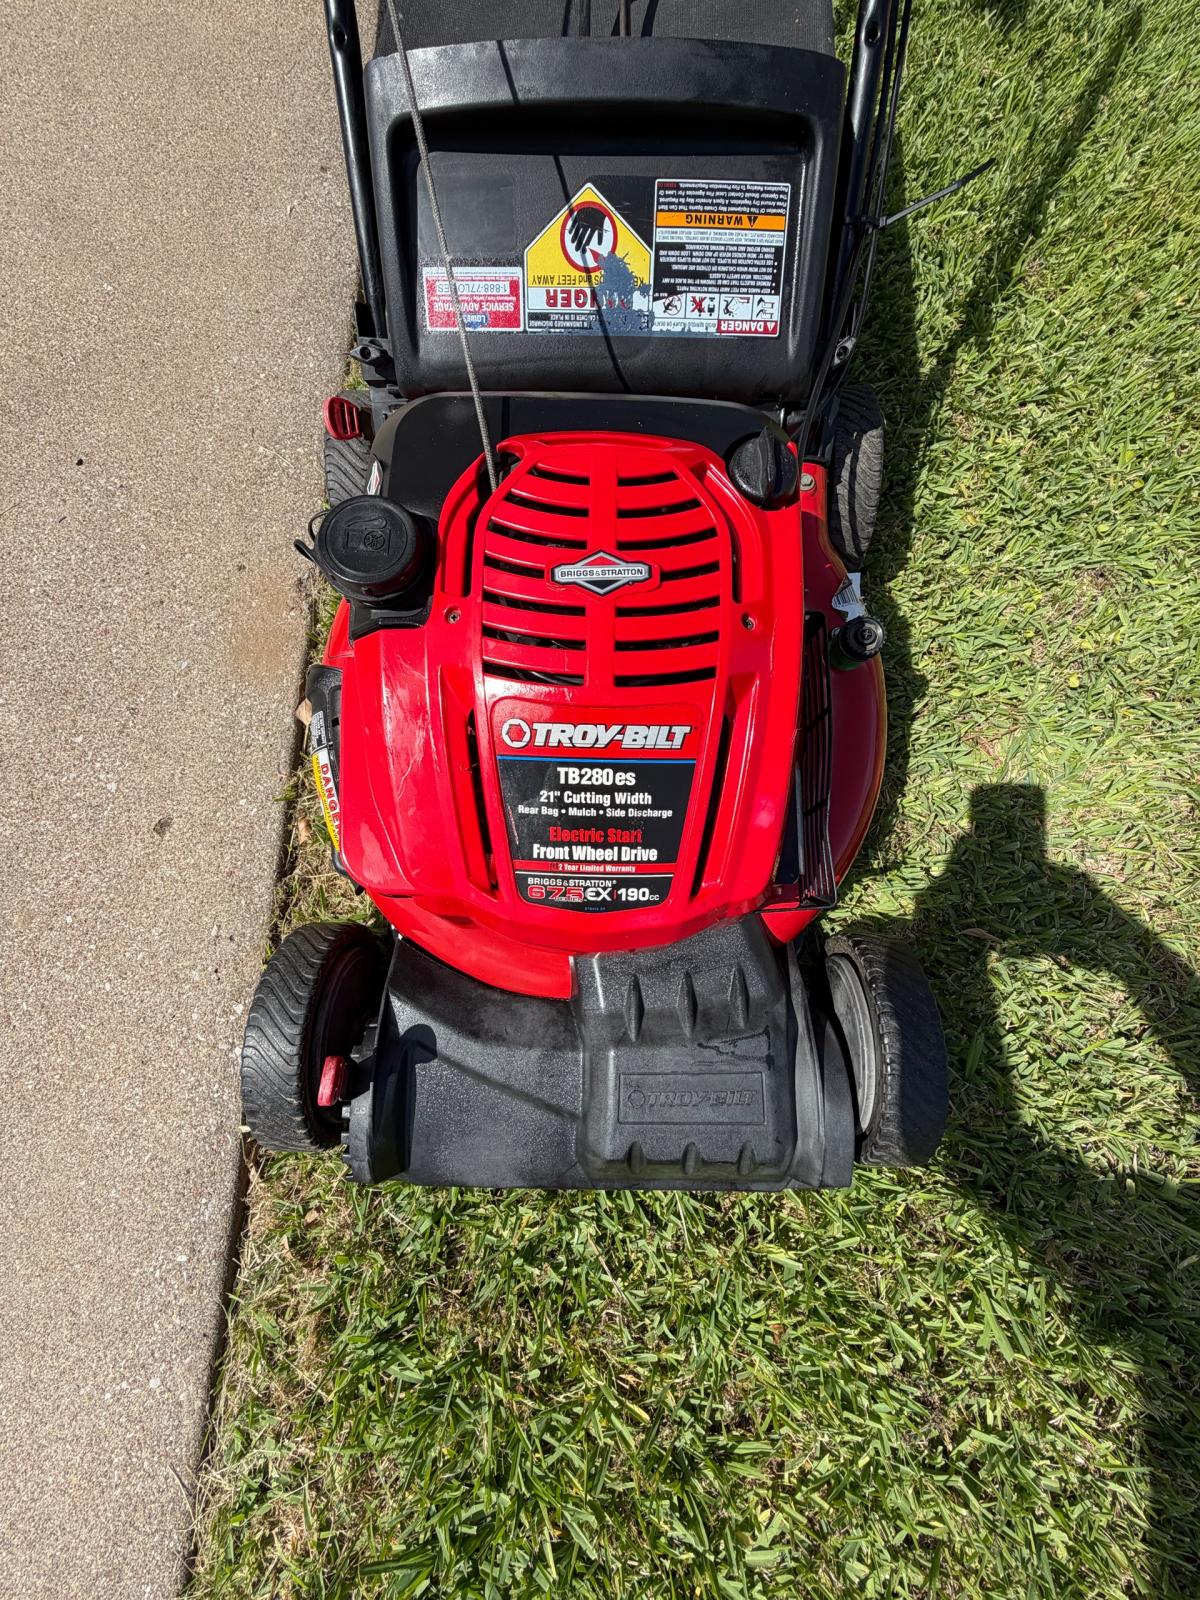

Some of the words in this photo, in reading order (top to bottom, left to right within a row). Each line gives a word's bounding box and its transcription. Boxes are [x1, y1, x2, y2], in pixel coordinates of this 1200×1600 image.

[685, 214, 743, 226] WARNING
[531, 274, 555, 285] AWAY
[557, 274, 577, 285] FEET
[578, 274, 592, 285] and
[437, 283, 507, 293] 1-888-77LOES
[481, 302, 514, 311] SERVICE
[720, 321, 765, 332] DANGER
[560, 569, 643, 577] BRIGGS&STRATTON
[531, 722, 692, 749] TROY-BILT
[539, 790, 561, 803] 21"
[563, 791, 611, 806] Cutting
[614, 792, 652, 805] Width
[518, 805, 539, 815] Rear
[541, 806, 559, 817] Bag
[568, 807, 597, 817] Mulch
[606, 808, 626, 817] Side
[628, 808, 673, 819] Discharge
[549, 826, 605, 843] Electric
[607, 828, 643, 843] Start
[532, 844, 570, 860] Front
[571, 845, 619, 861] Wheel
[621, 846, 658, 862] Drive
[605, 865, 636, 873] Warranty
[646, 1090, 757, 1108] TROY-BILT
